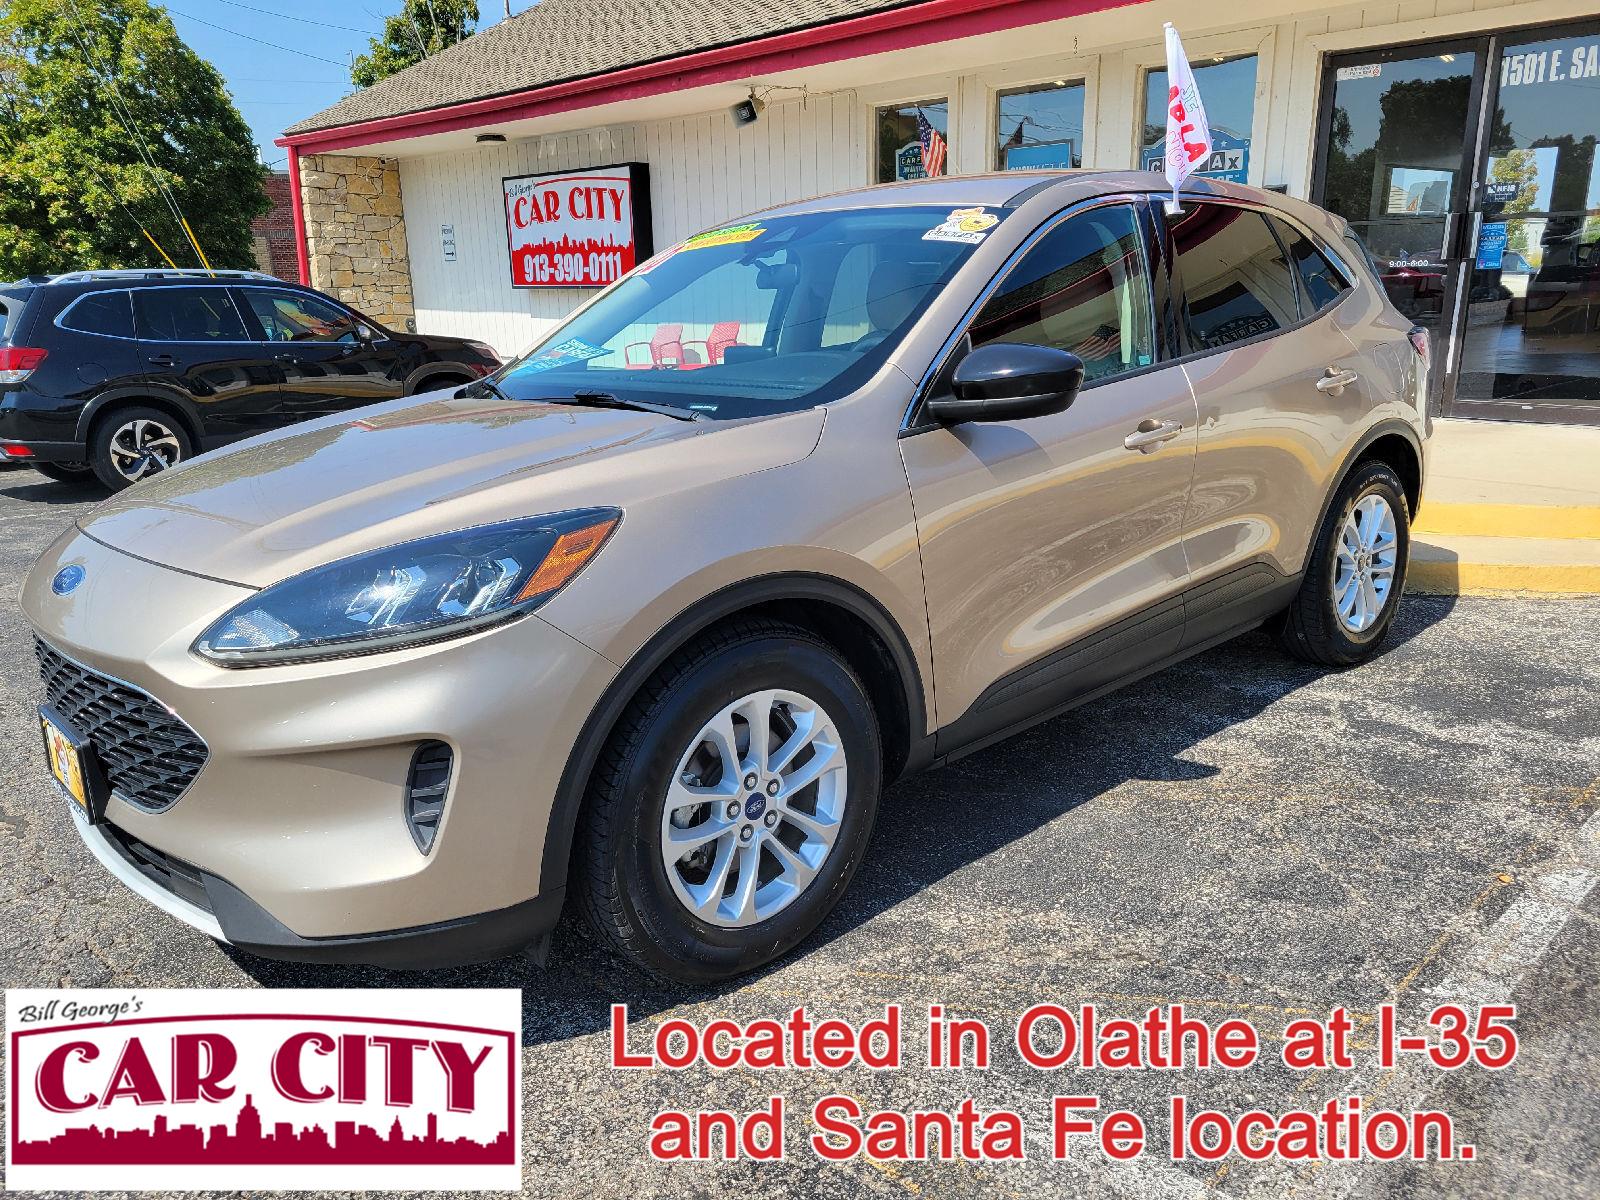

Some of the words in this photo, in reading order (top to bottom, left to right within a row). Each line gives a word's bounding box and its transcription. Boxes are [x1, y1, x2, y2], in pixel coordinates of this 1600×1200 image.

[1501, 51, 1547, 87] 1501
[1549, 49, 1566, 82] E.
[1570, 44, 1600, 79] SA
[513, 189, 561, 229] CAR
[567, 186, 625, 223] CITY
[523, 251, 622, 283] 913-390-0111
